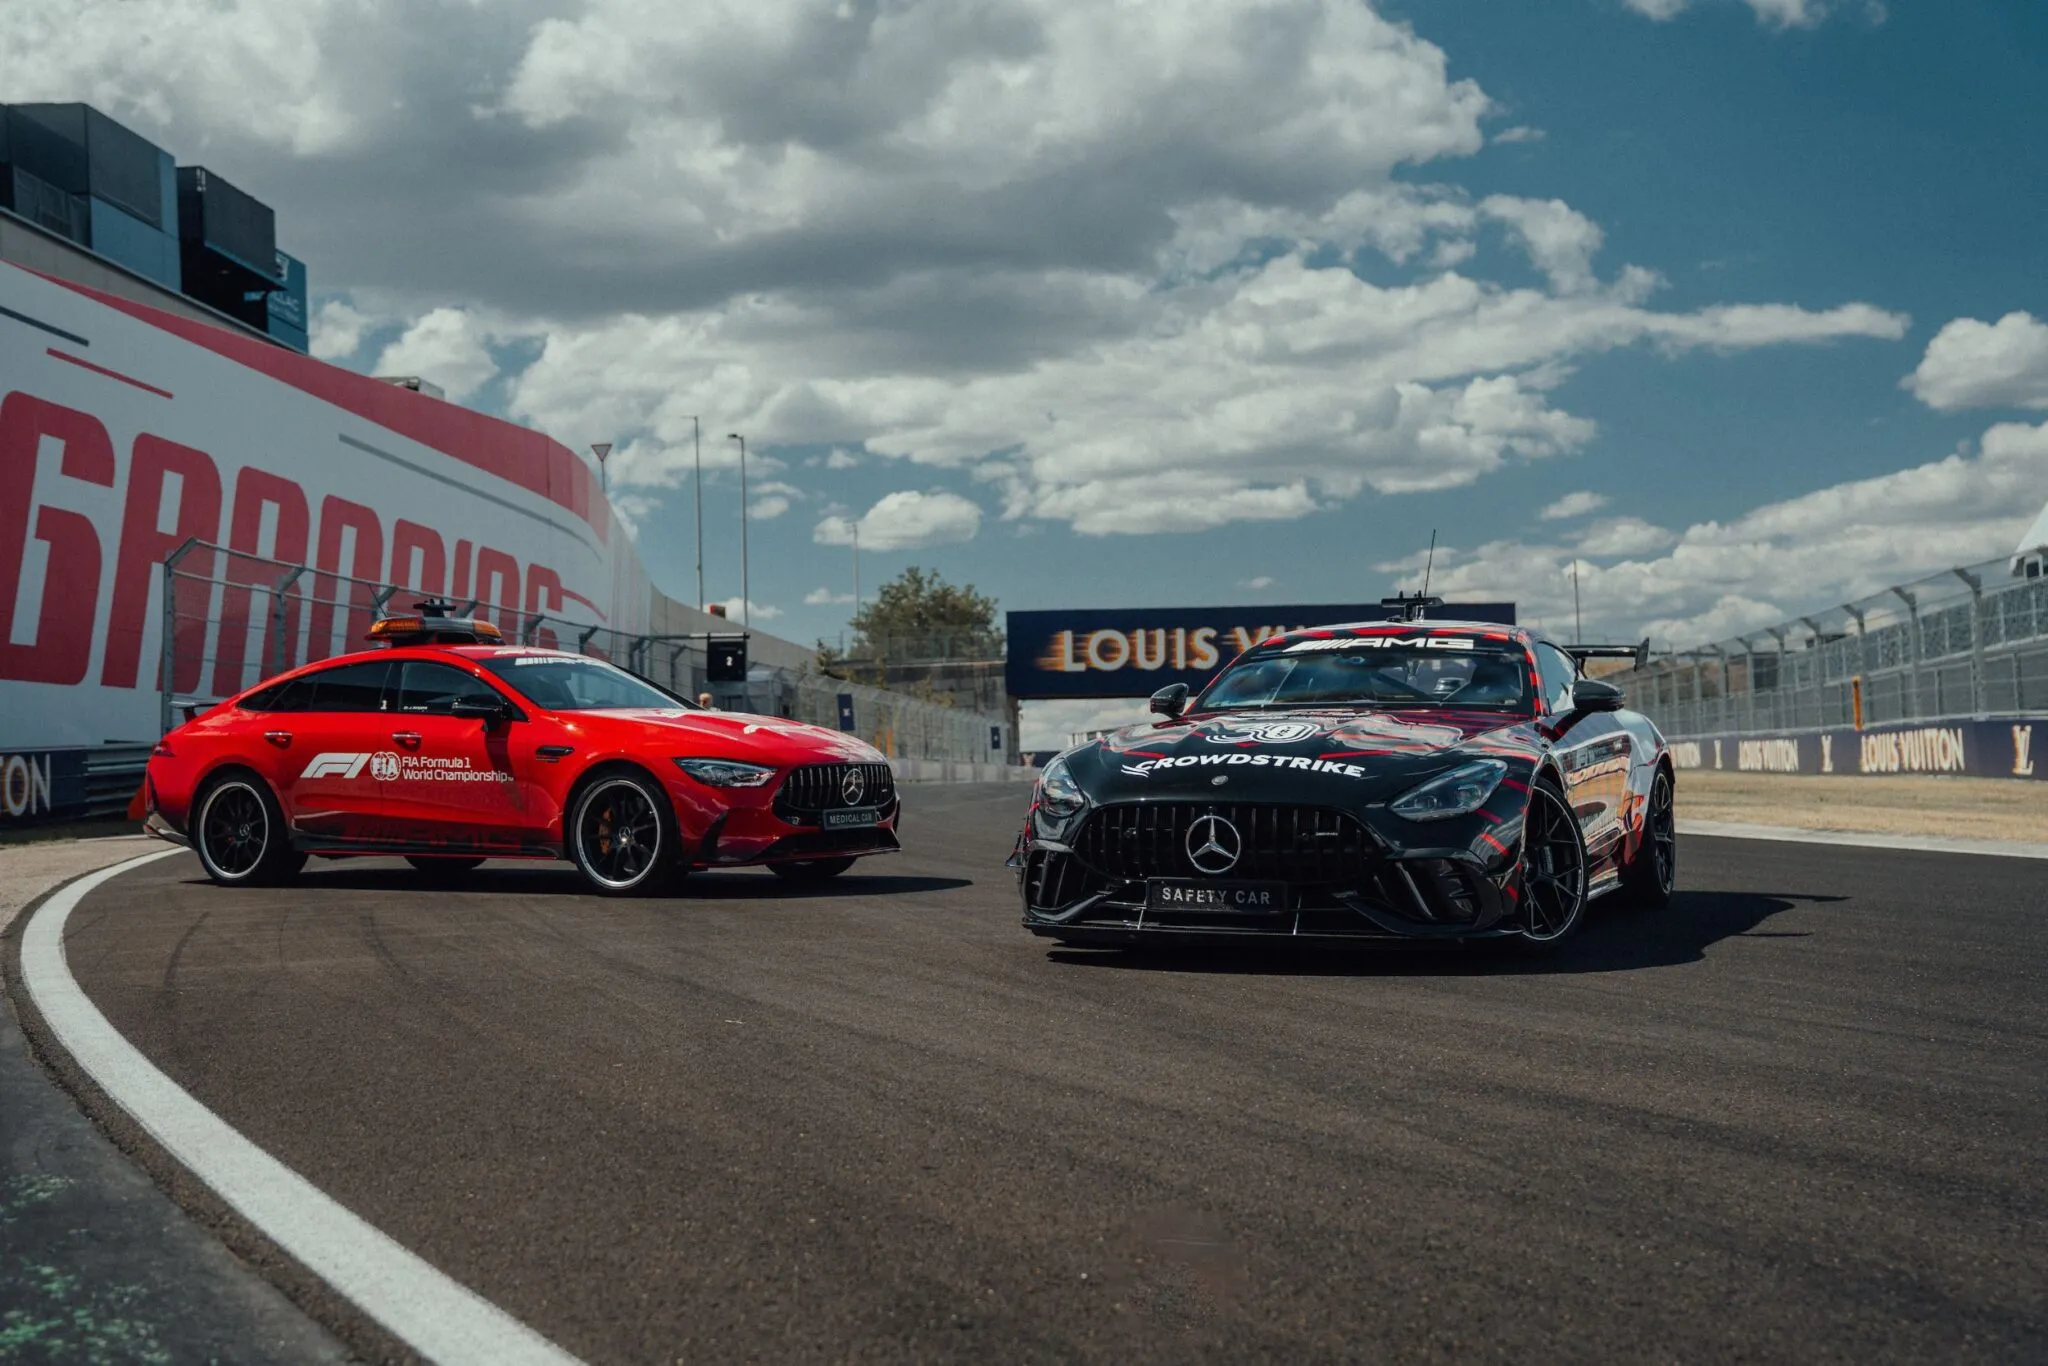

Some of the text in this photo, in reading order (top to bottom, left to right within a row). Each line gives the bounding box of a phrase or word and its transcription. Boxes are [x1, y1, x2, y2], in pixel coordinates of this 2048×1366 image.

[1063, 627, 1220, 672] LOUIS
[1861, 728, 1965, 772] LOUIS VUITTON
[402, 757, 471, 768] FIA Formula 1
[403, 769, 433, 780] World
[0, 753, 51, 817] ON
[829, 812, 873, 825] MEDICAL CAR
[1162, 887, 1271, 905] SAFETY CAR
